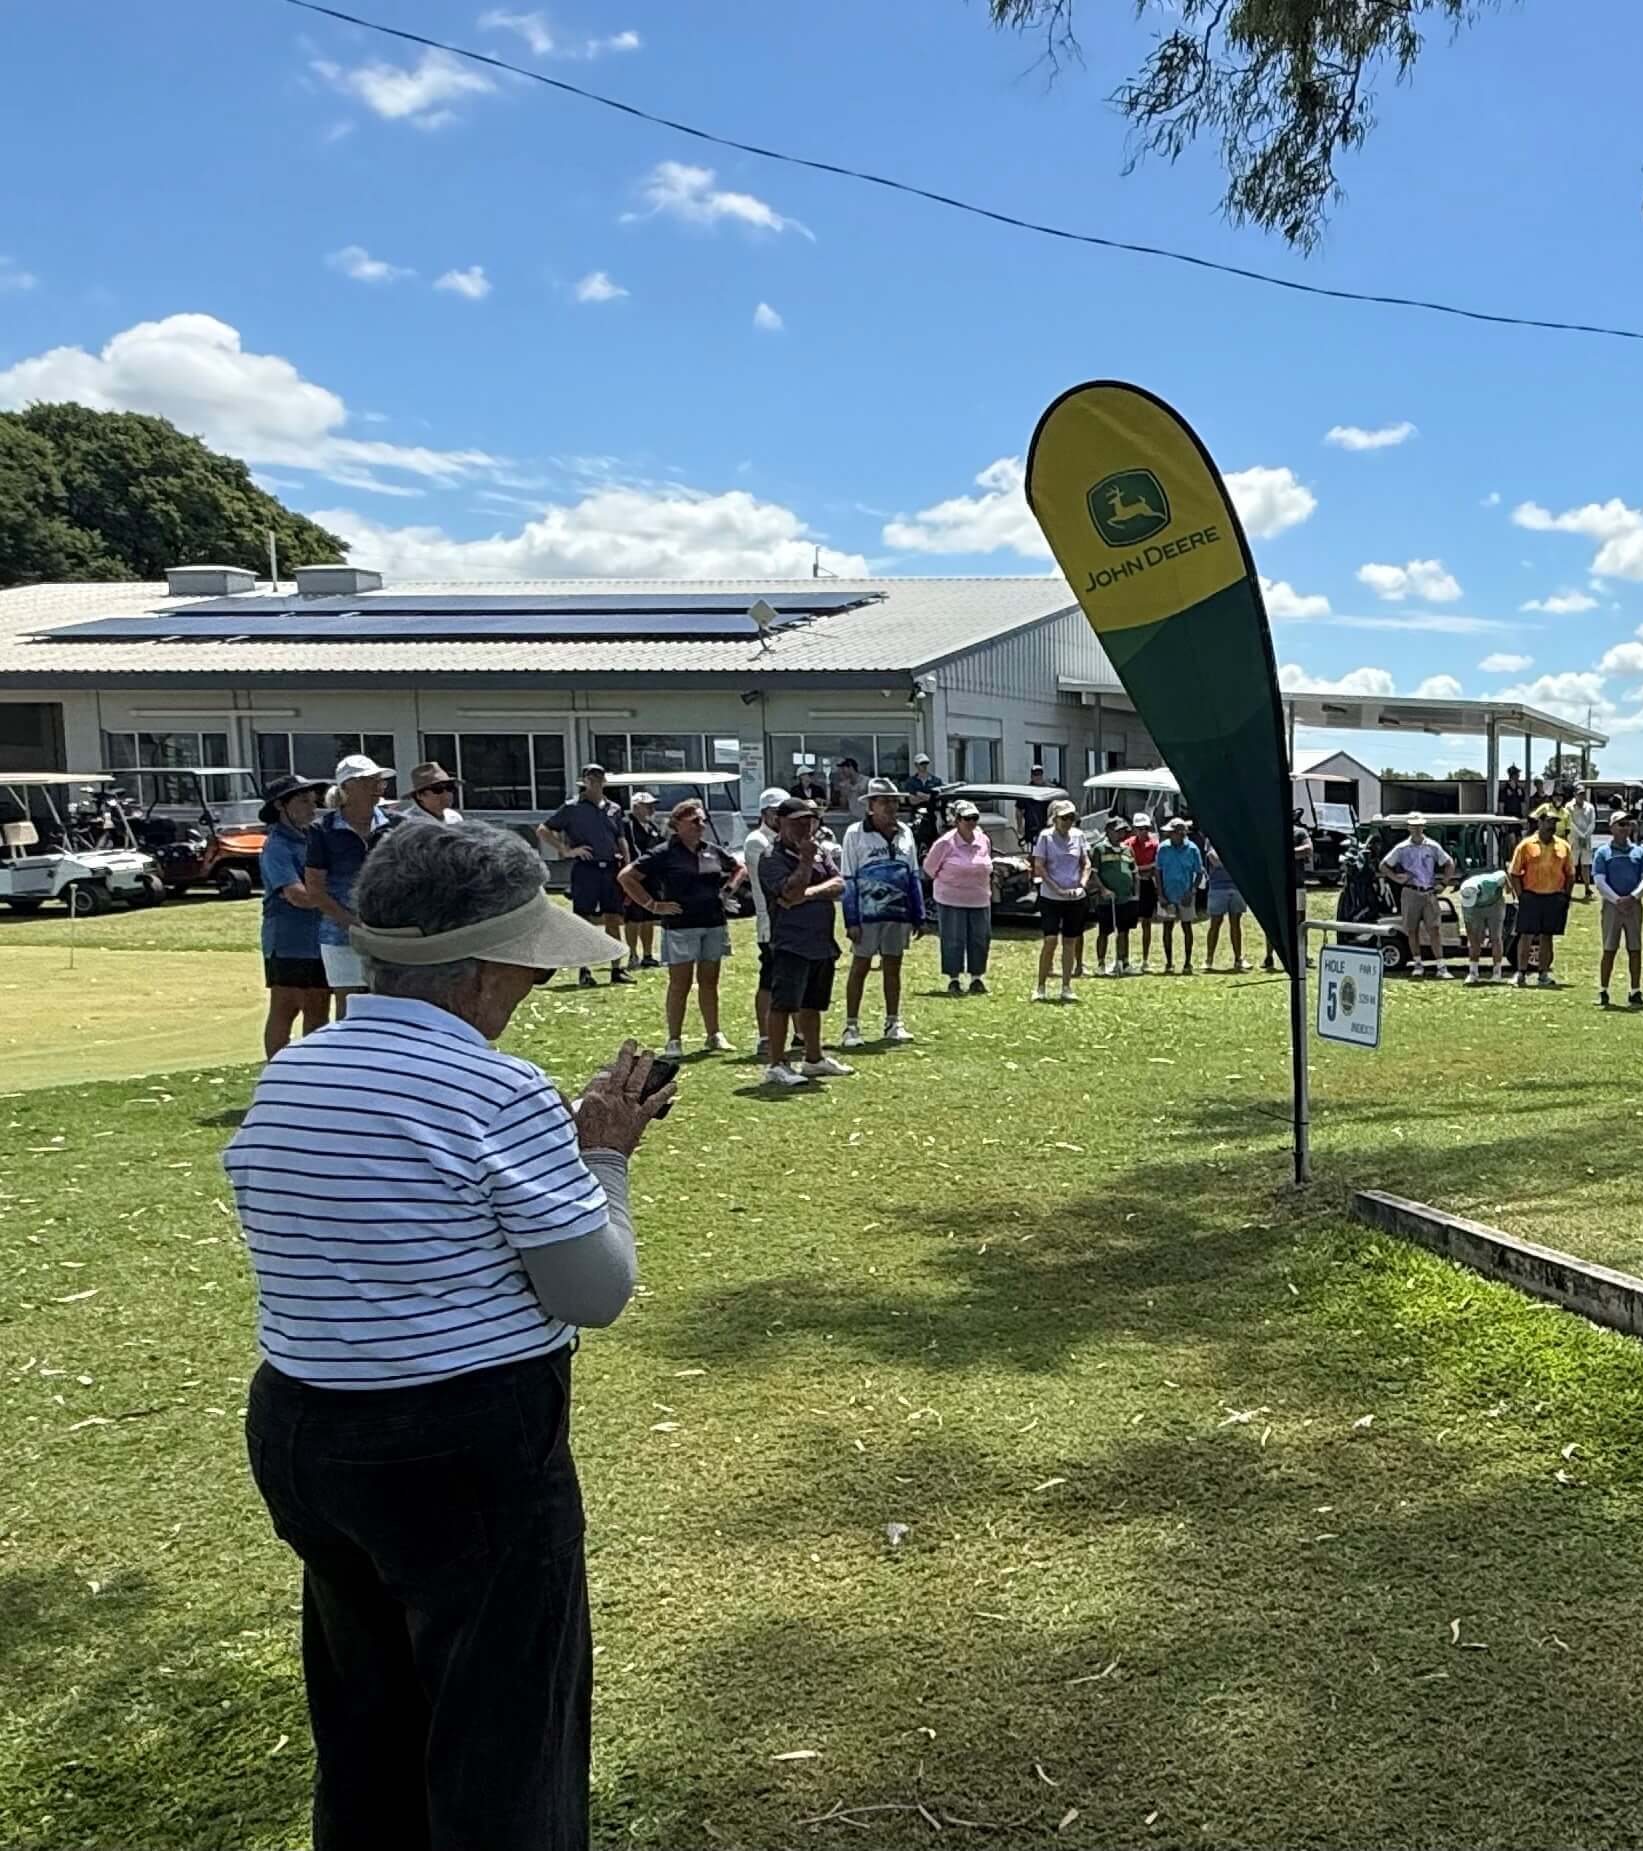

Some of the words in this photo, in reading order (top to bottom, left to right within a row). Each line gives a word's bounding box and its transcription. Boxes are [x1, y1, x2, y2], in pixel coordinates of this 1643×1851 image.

[1086, 557, 1144, 593] JOHN
[1143, 526, 1221, 567] DEERE
[1325, 960, 1345, 974] HOLE
[1327, 981, 1337, 1022] 5
